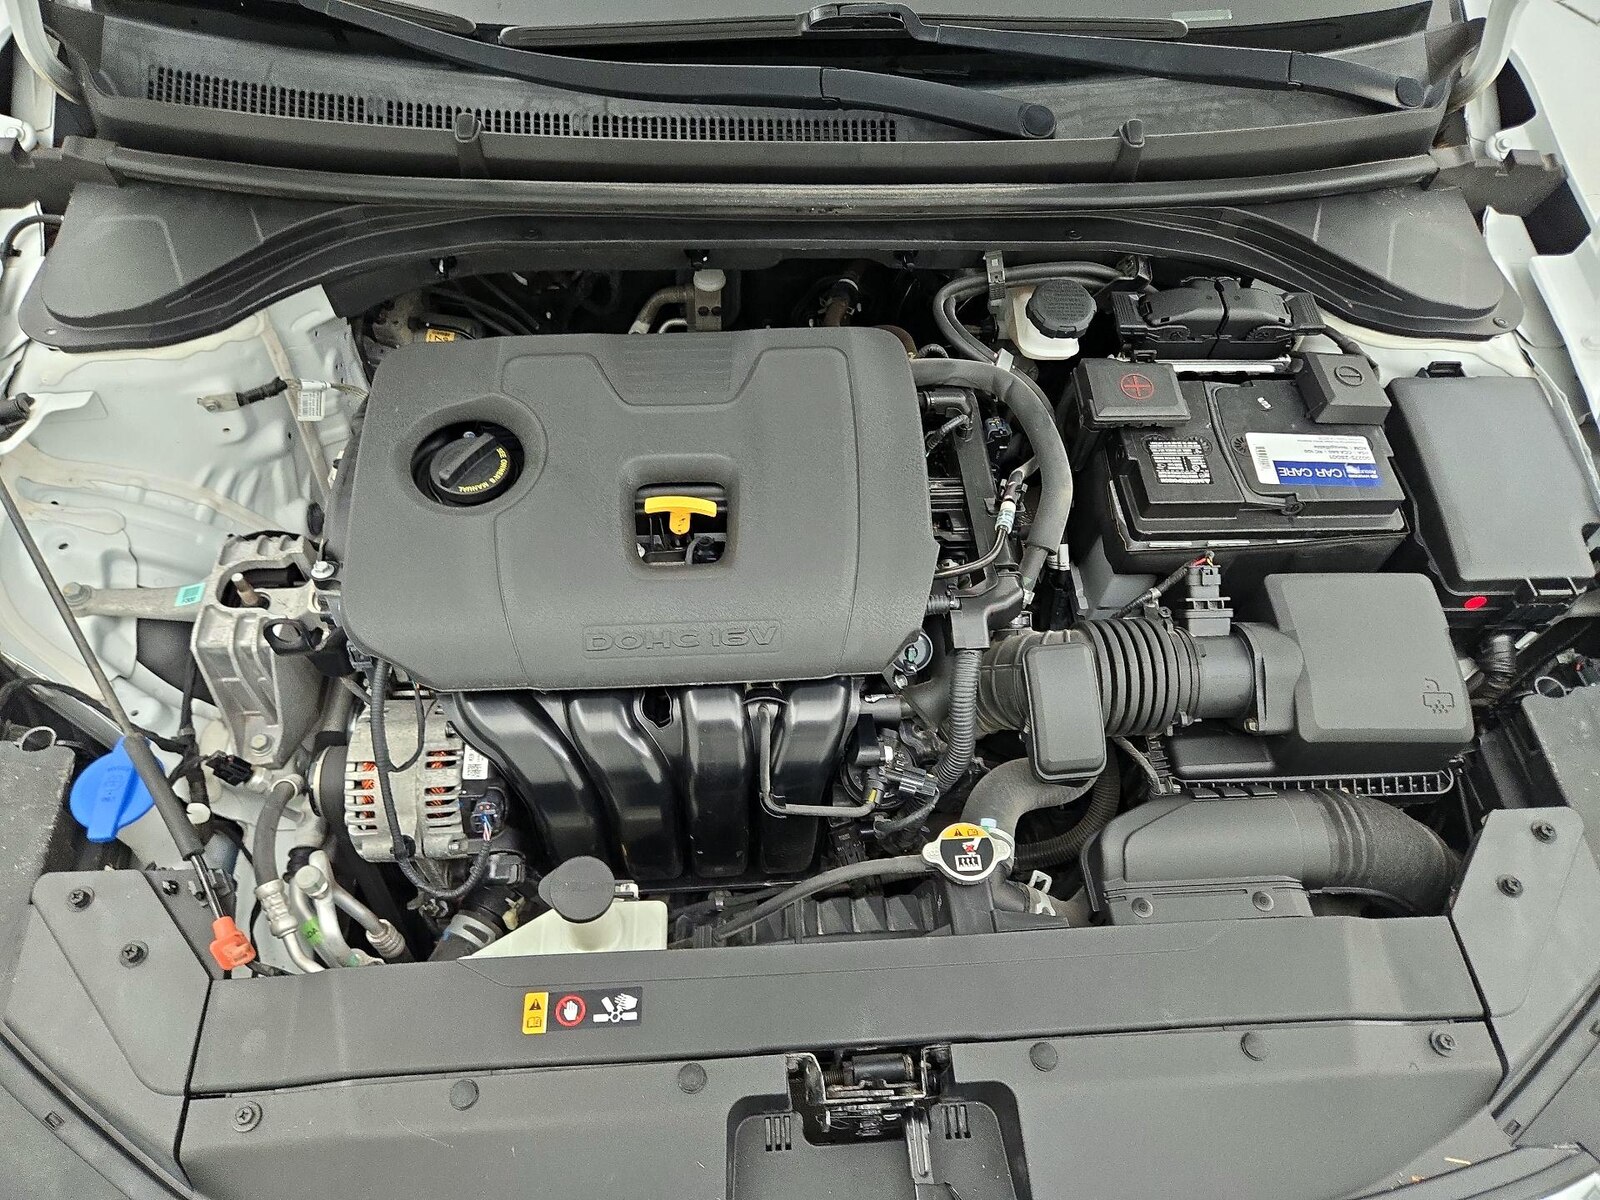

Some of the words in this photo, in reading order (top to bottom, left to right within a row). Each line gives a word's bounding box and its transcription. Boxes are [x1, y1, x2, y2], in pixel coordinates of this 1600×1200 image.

[496, 447, 507, 459] SEE
[1278, 467, 1313, 477] CARE
[1315, 468, 1343, 478] CAR
[458, 482, 489, 493] MANUAL
[586, 631, 700, 652] DOHC
[710, 626, 778, 648] 16V
